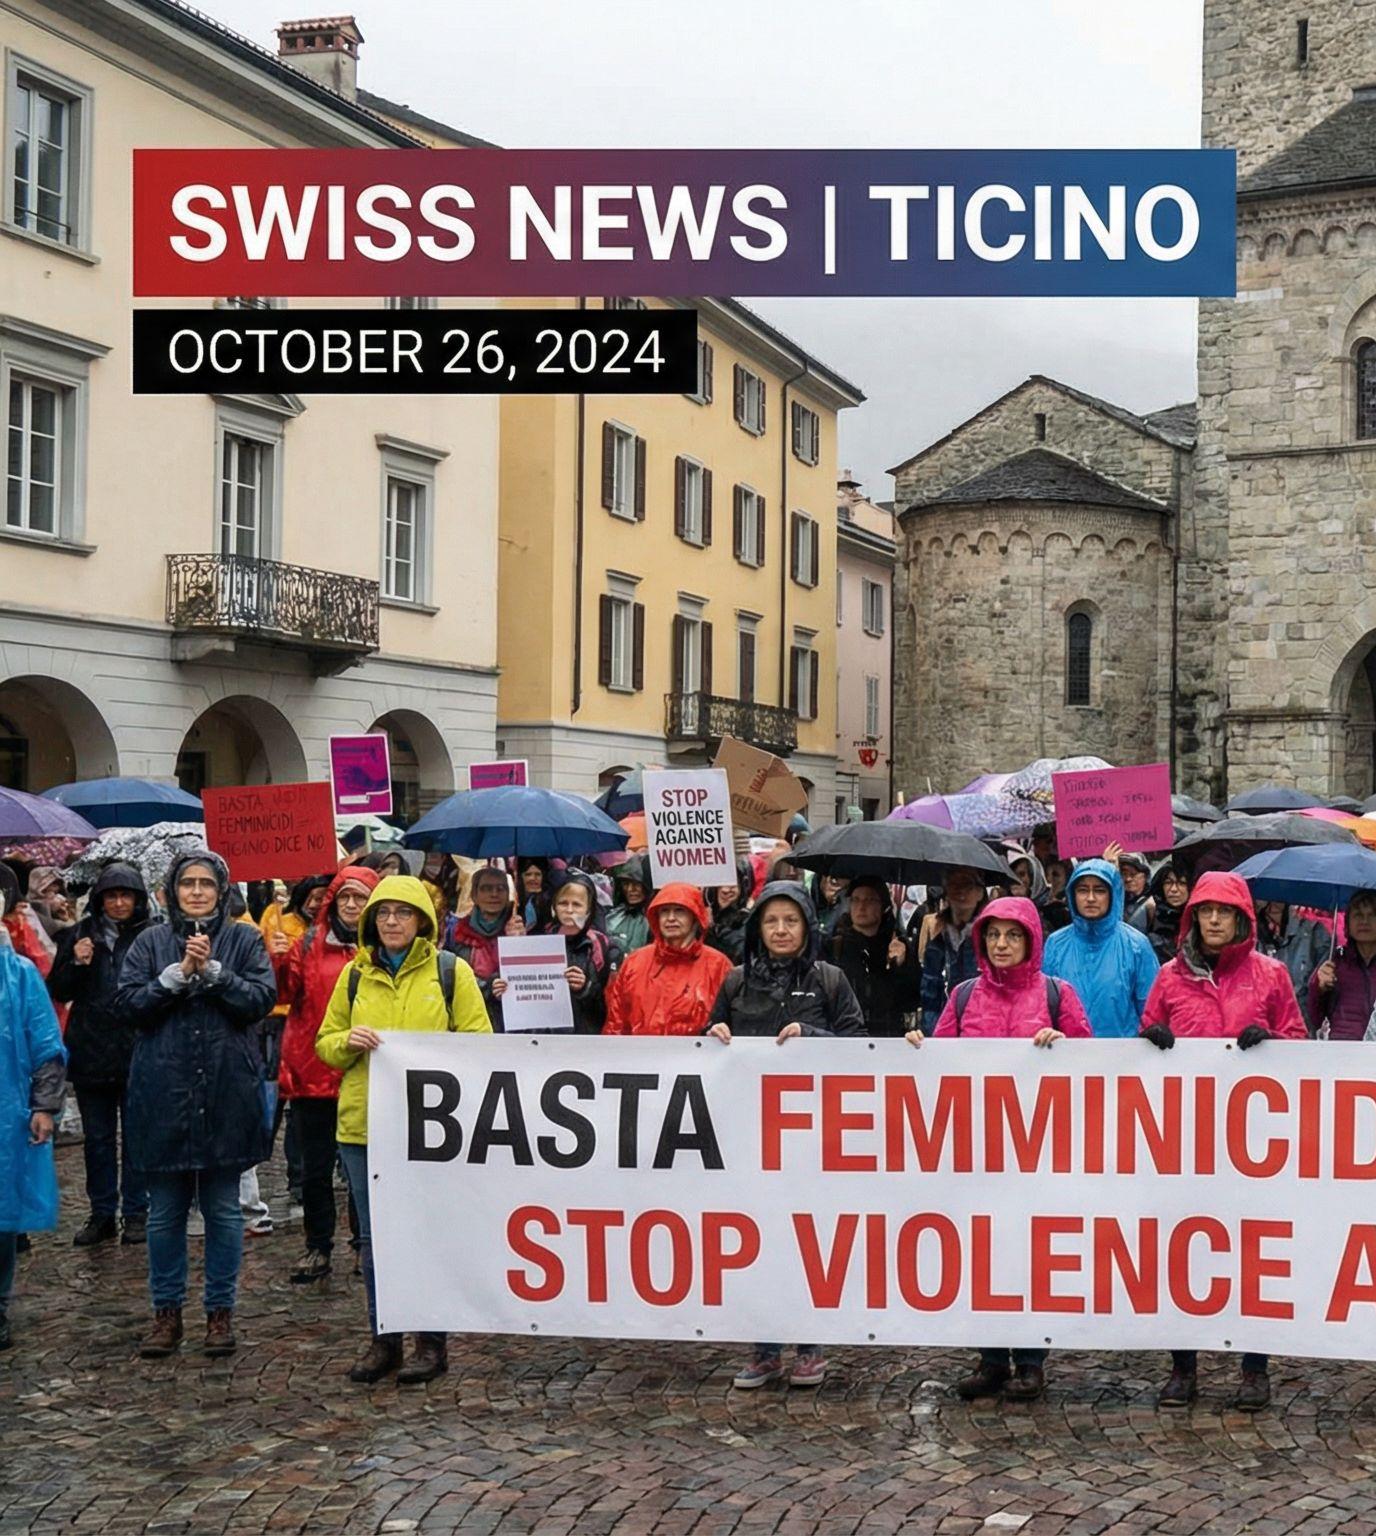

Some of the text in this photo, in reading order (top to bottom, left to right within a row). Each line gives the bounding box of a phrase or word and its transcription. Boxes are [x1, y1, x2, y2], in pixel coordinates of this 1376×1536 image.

[218, 793, 264, 813] BASTA
[661, 788, 708, 808] STOP
[652, 809, 725, 827] VIOLENCE
[275, 834, 302, 853] DICE
[307, 833, 326, 852] NO
[655, 827, 723, 846] AGAINST
[656, 847, 727, 868] WOMEN
[405, 1069, 725, 1170] BASTA
[506, 1205, 761, 1306] STOP
[792, 1212, 1295, 1320] VIOLENCE
